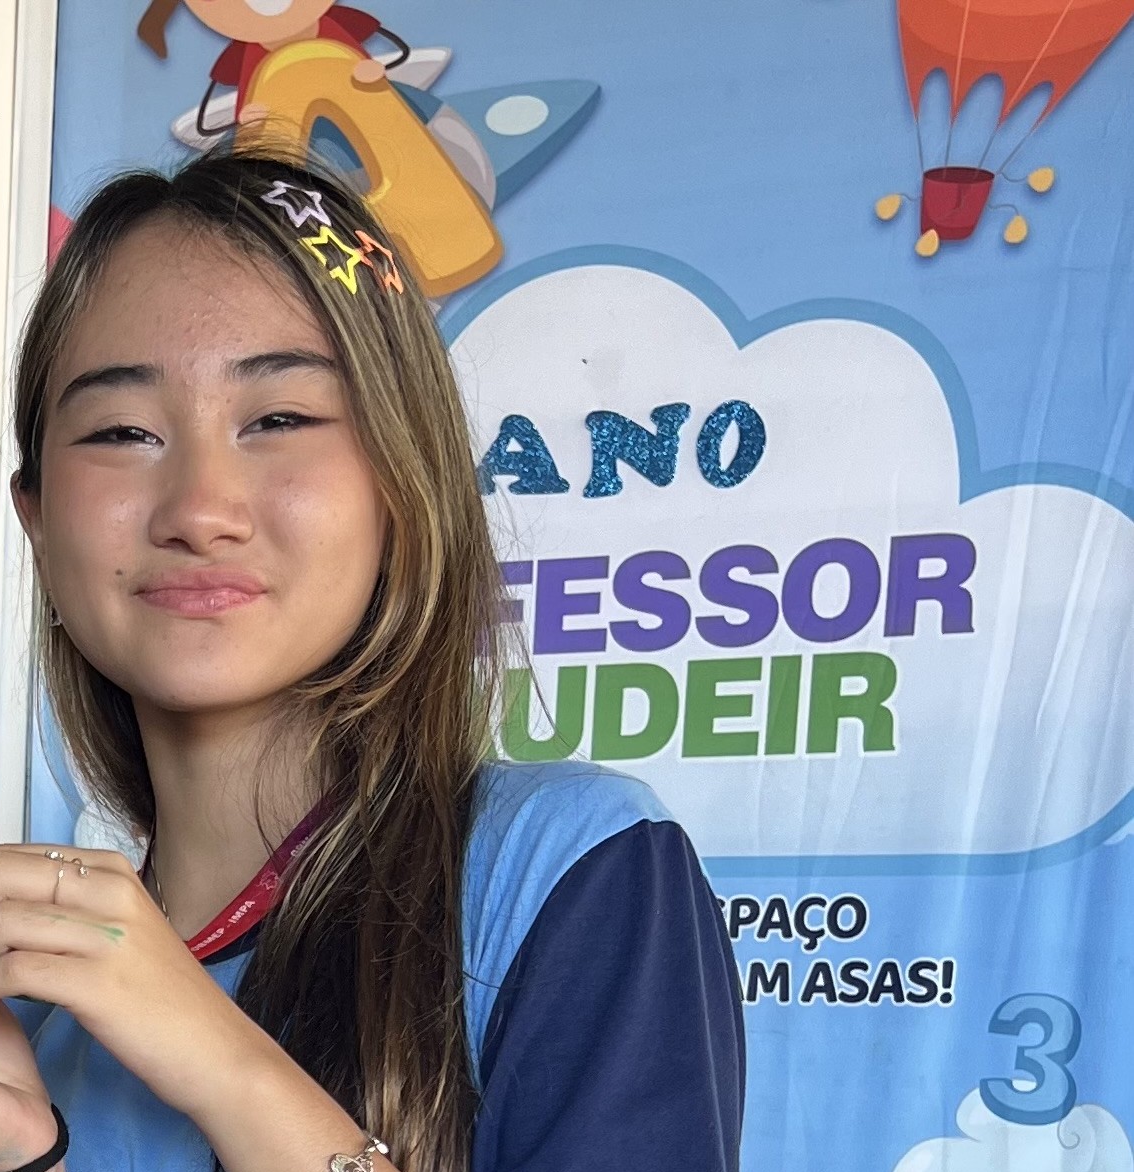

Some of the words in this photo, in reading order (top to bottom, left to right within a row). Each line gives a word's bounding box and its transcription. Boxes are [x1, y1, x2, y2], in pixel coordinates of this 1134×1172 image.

[475, 399, 767, 498] ANO
[474, 533, 977, 655] FESSOR
[484, 652, 898, 762] UDEIR
[227, 900, 256, 924] IMPA
[717, 895, 868, 951] PAÇO
[800, 960, 956, 1004] ASAS!
[979, 992, 1082, 1126] 3
